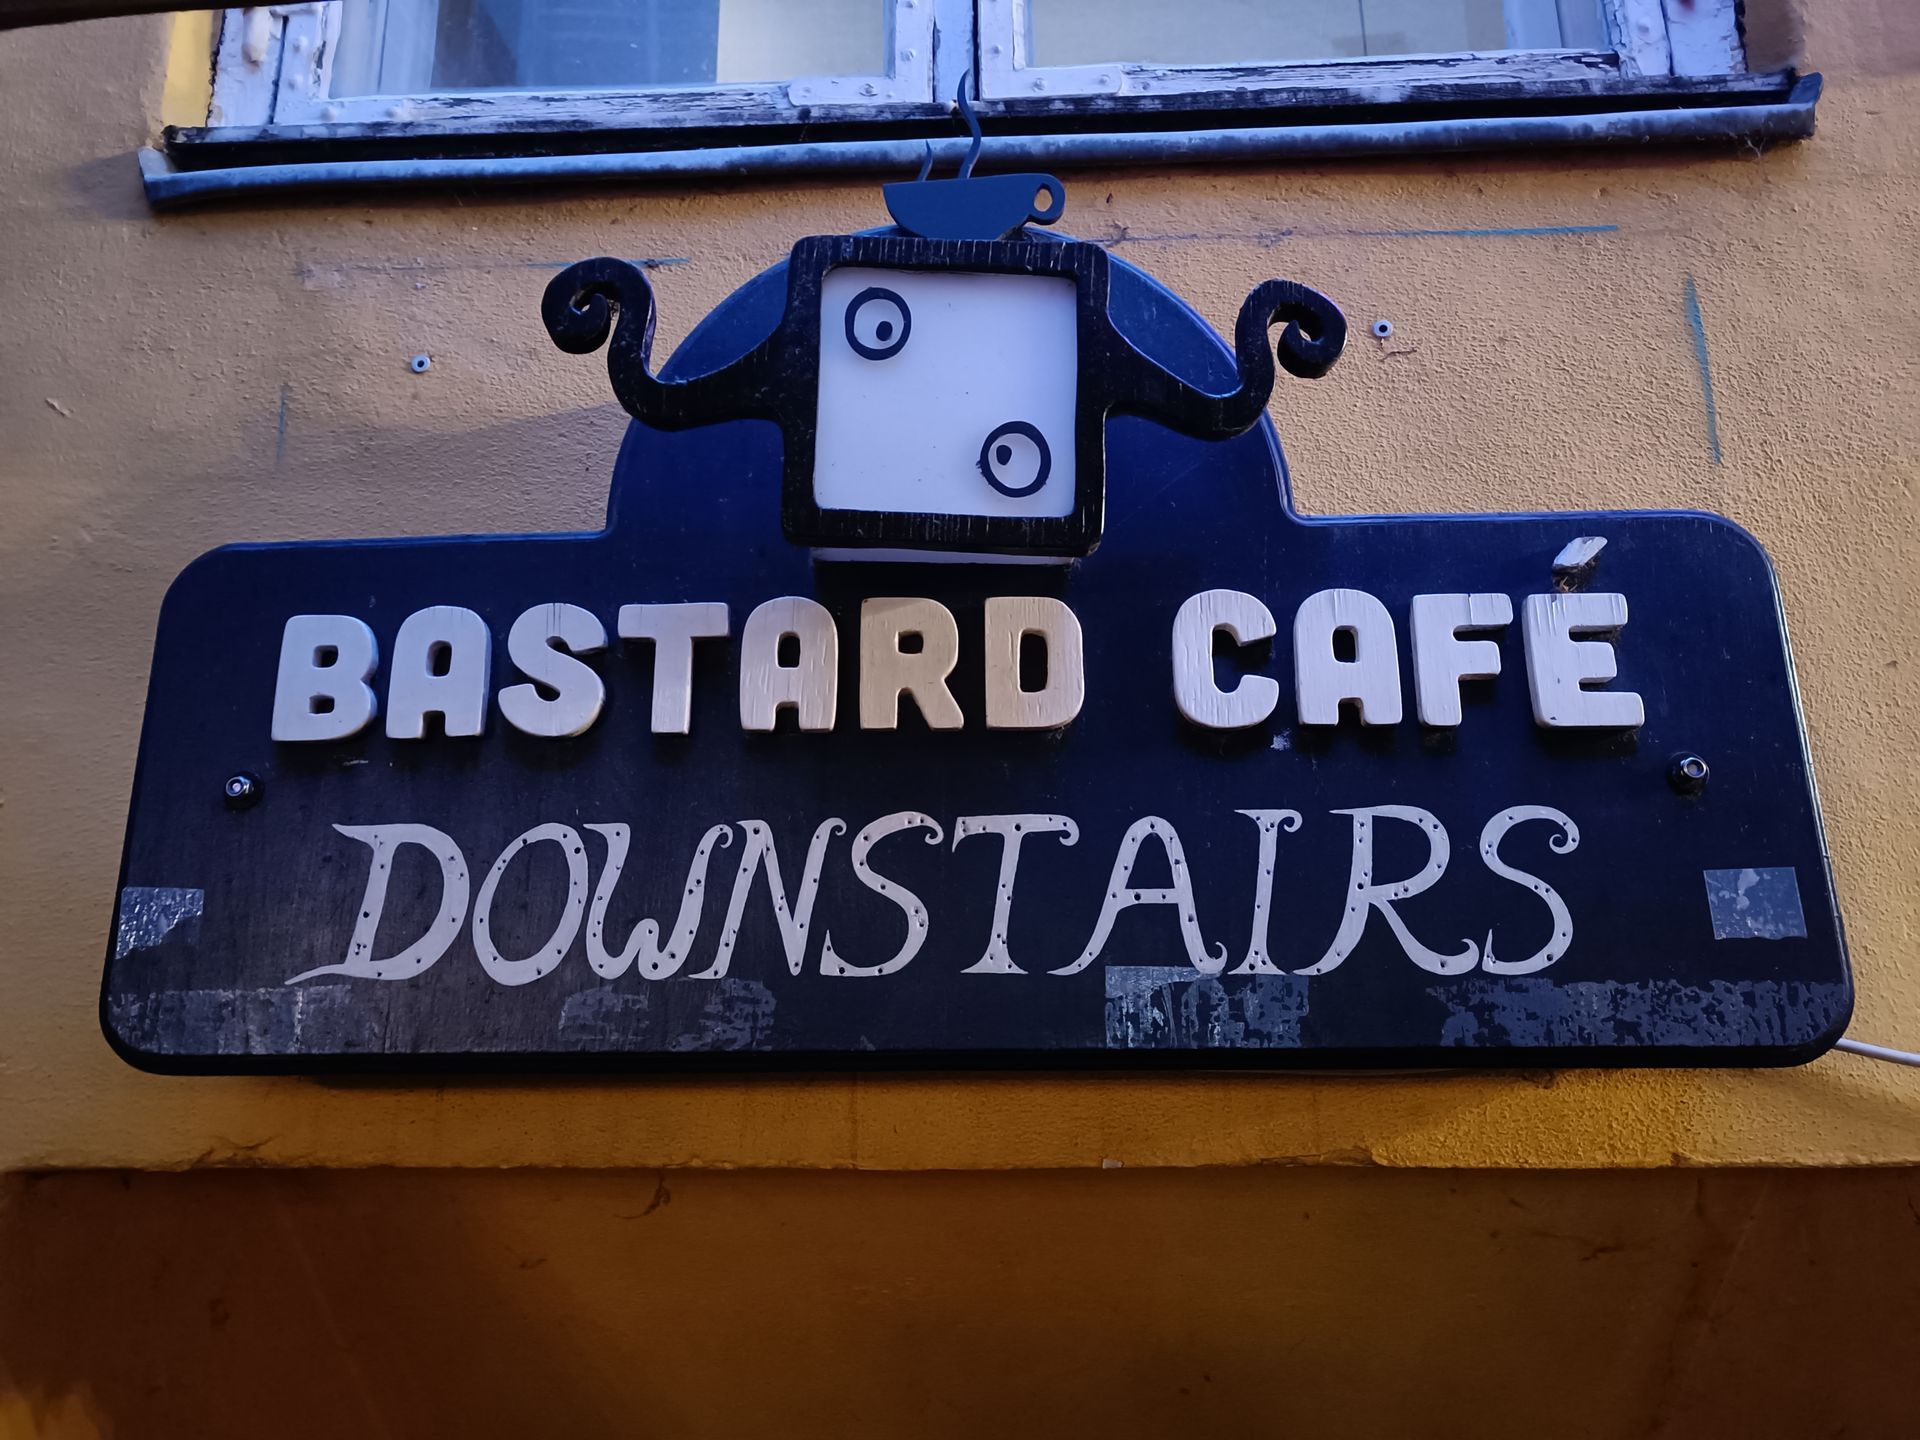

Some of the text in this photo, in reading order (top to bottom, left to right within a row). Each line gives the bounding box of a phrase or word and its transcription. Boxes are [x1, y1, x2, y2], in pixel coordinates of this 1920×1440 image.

[270, 535, 1647, 742] BASTARD CAFÉ
[284, 804, 1581, 986] DOWNSTAIRS
